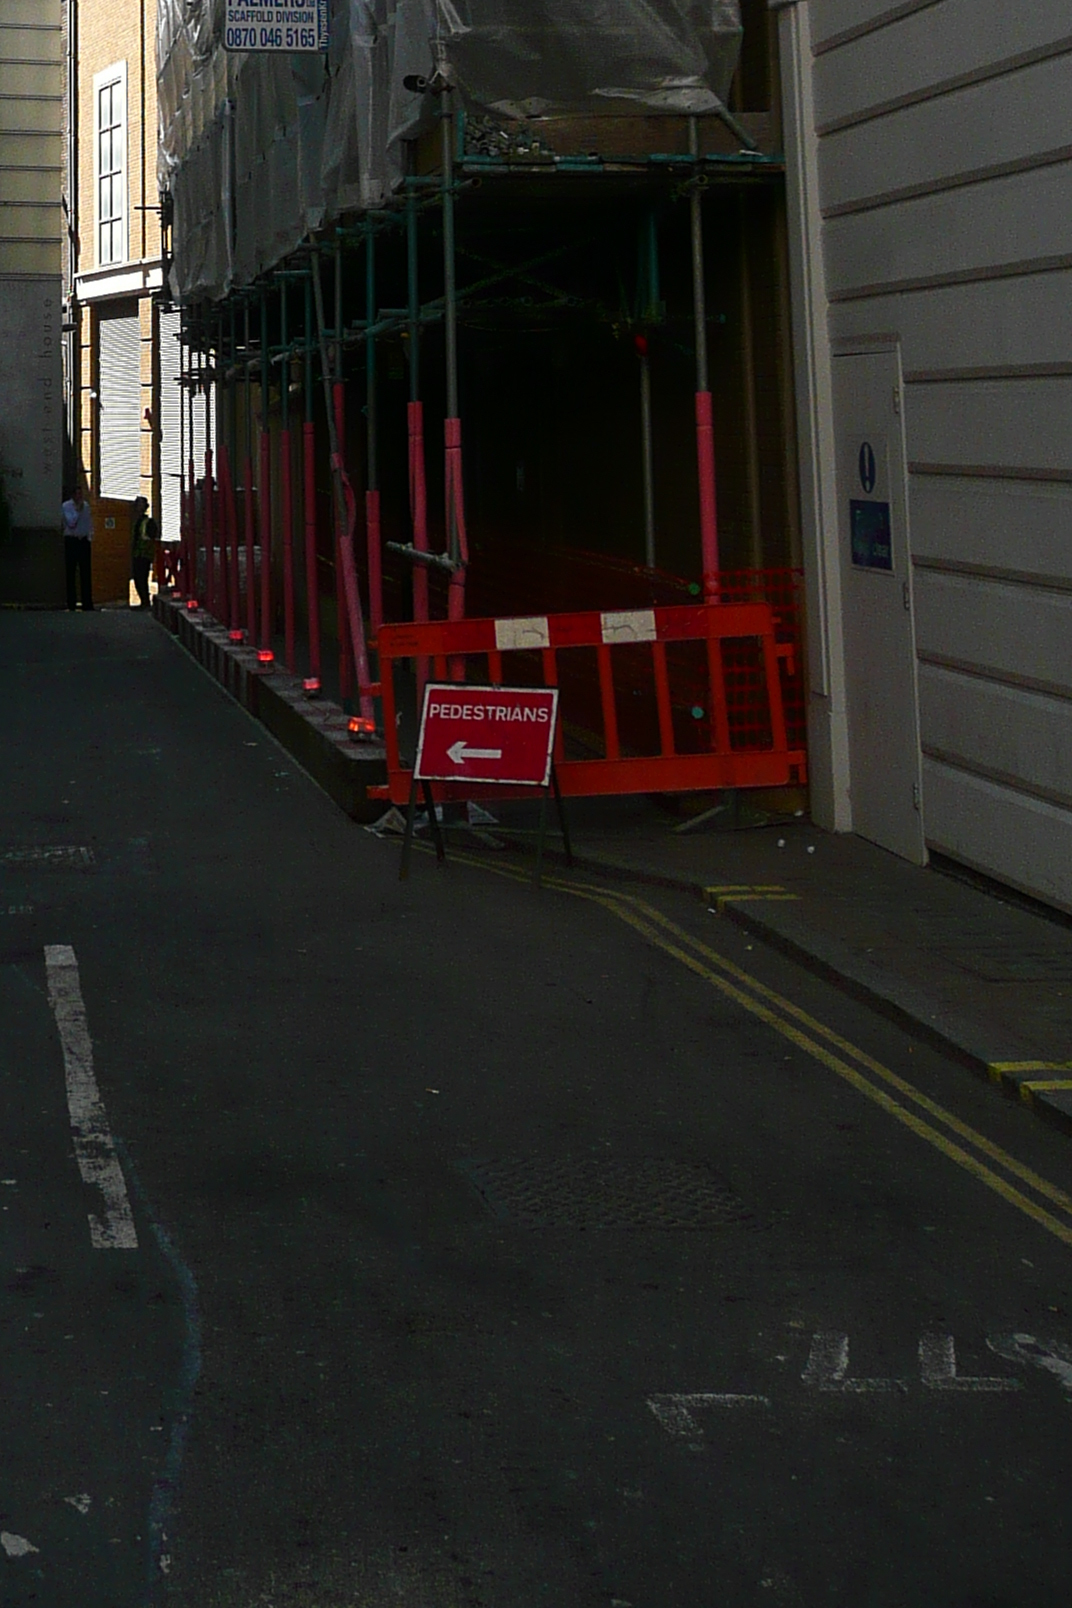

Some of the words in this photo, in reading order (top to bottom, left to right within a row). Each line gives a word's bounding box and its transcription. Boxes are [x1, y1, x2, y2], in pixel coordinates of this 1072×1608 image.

[229, 10, 273, 22] SCAFFOLD
[276, 11, 314, 23] DIVISION
[227, 28, 256, 47] 0870
[260, 28, 282, 47] 046
[286, 28, 315, 47] 5165
[38, 298, 52, 358] house
[38, 378, 52, 414] end
[429, 703, 549, 722] PEDESTRIANS
